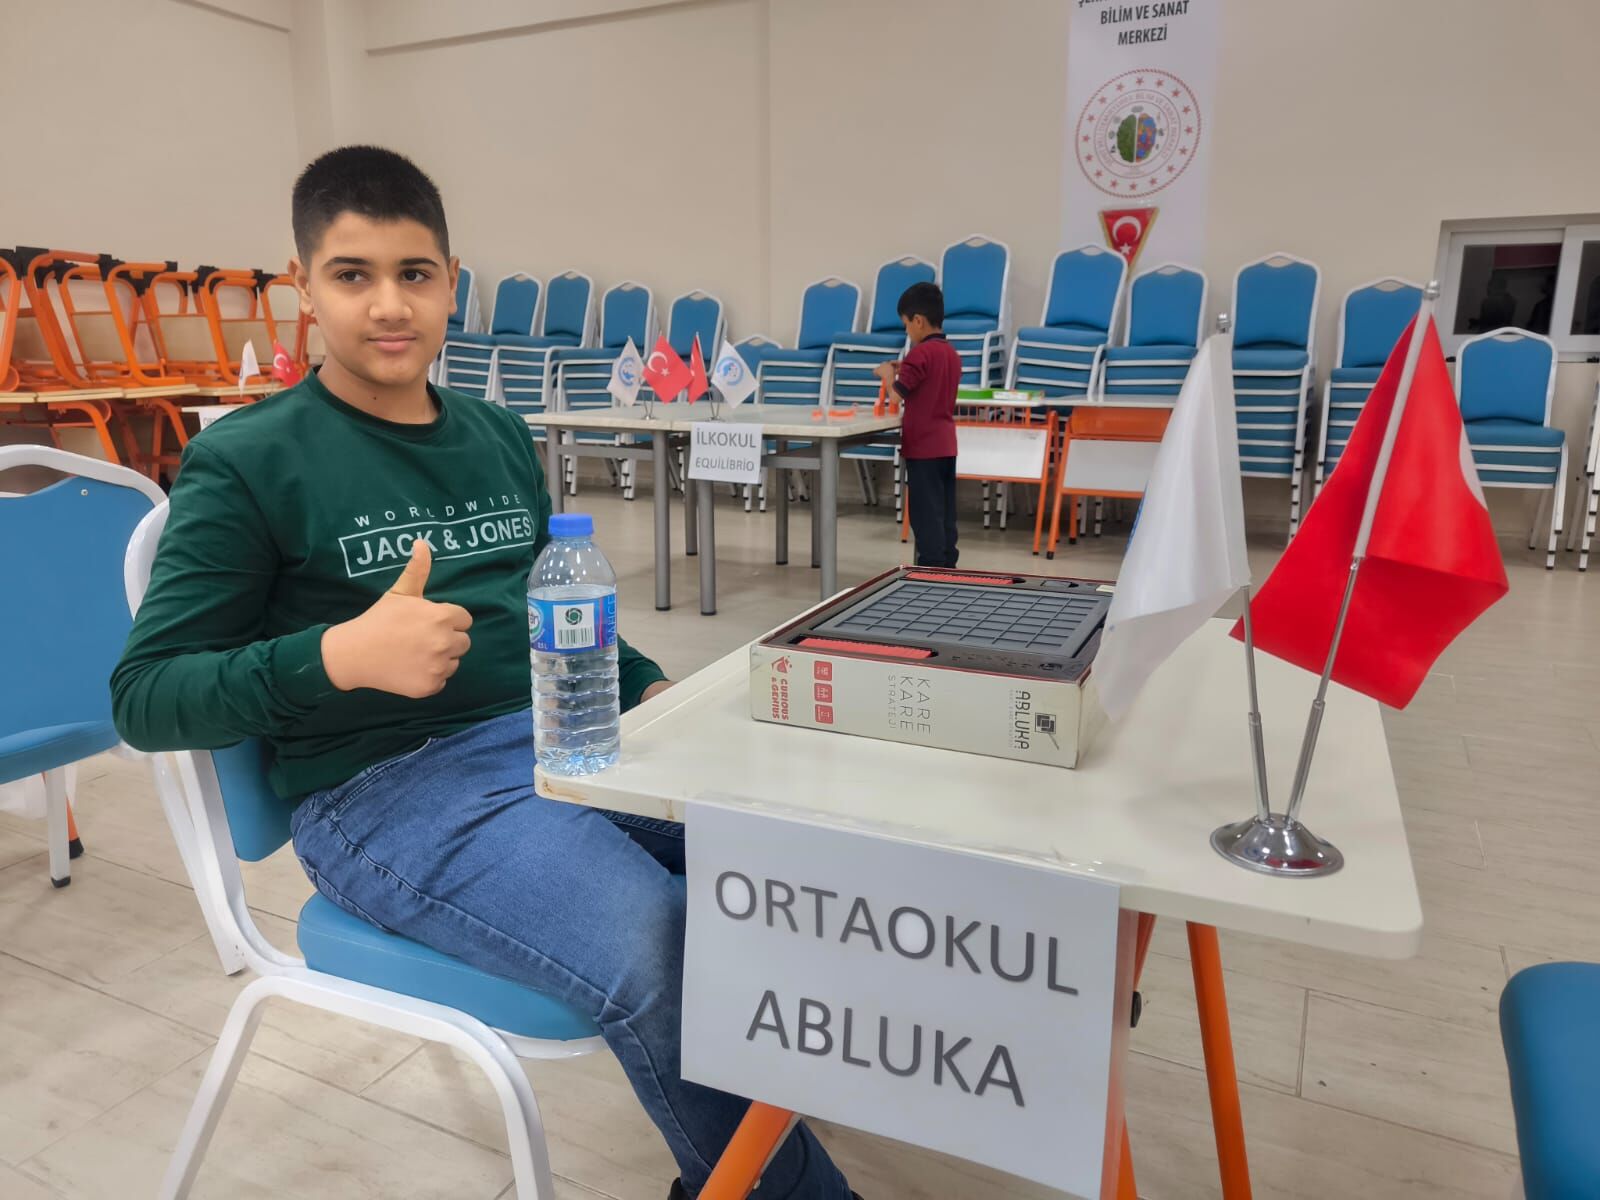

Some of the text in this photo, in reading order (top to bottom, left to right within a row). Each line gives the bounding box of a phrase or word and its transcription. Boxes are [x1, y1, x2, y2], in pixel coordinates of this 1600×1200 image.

[1100, 0, 1190, 25] BİLİM VE SANAT
[1117, 23, 1168, 46] MERKEZİ
[696, 427, 757, 449] İLKOKUL
[354, 494, 521, 528] WORLDWIDE
[356, 516, 532, 566] JACK & JONES
[771, 684, 780, 719] GENIUS
[780, 678, 789, 721] CURIOUS
[900, 676, 914, 732] KARE
[917, 678, 931, 736] KARE
[1014, 690, 1031, 750] ABLUKA
[715, 869, 1079, 996] ORTAOKUL
[745, 989, 1026, 1108] ABLUKA
